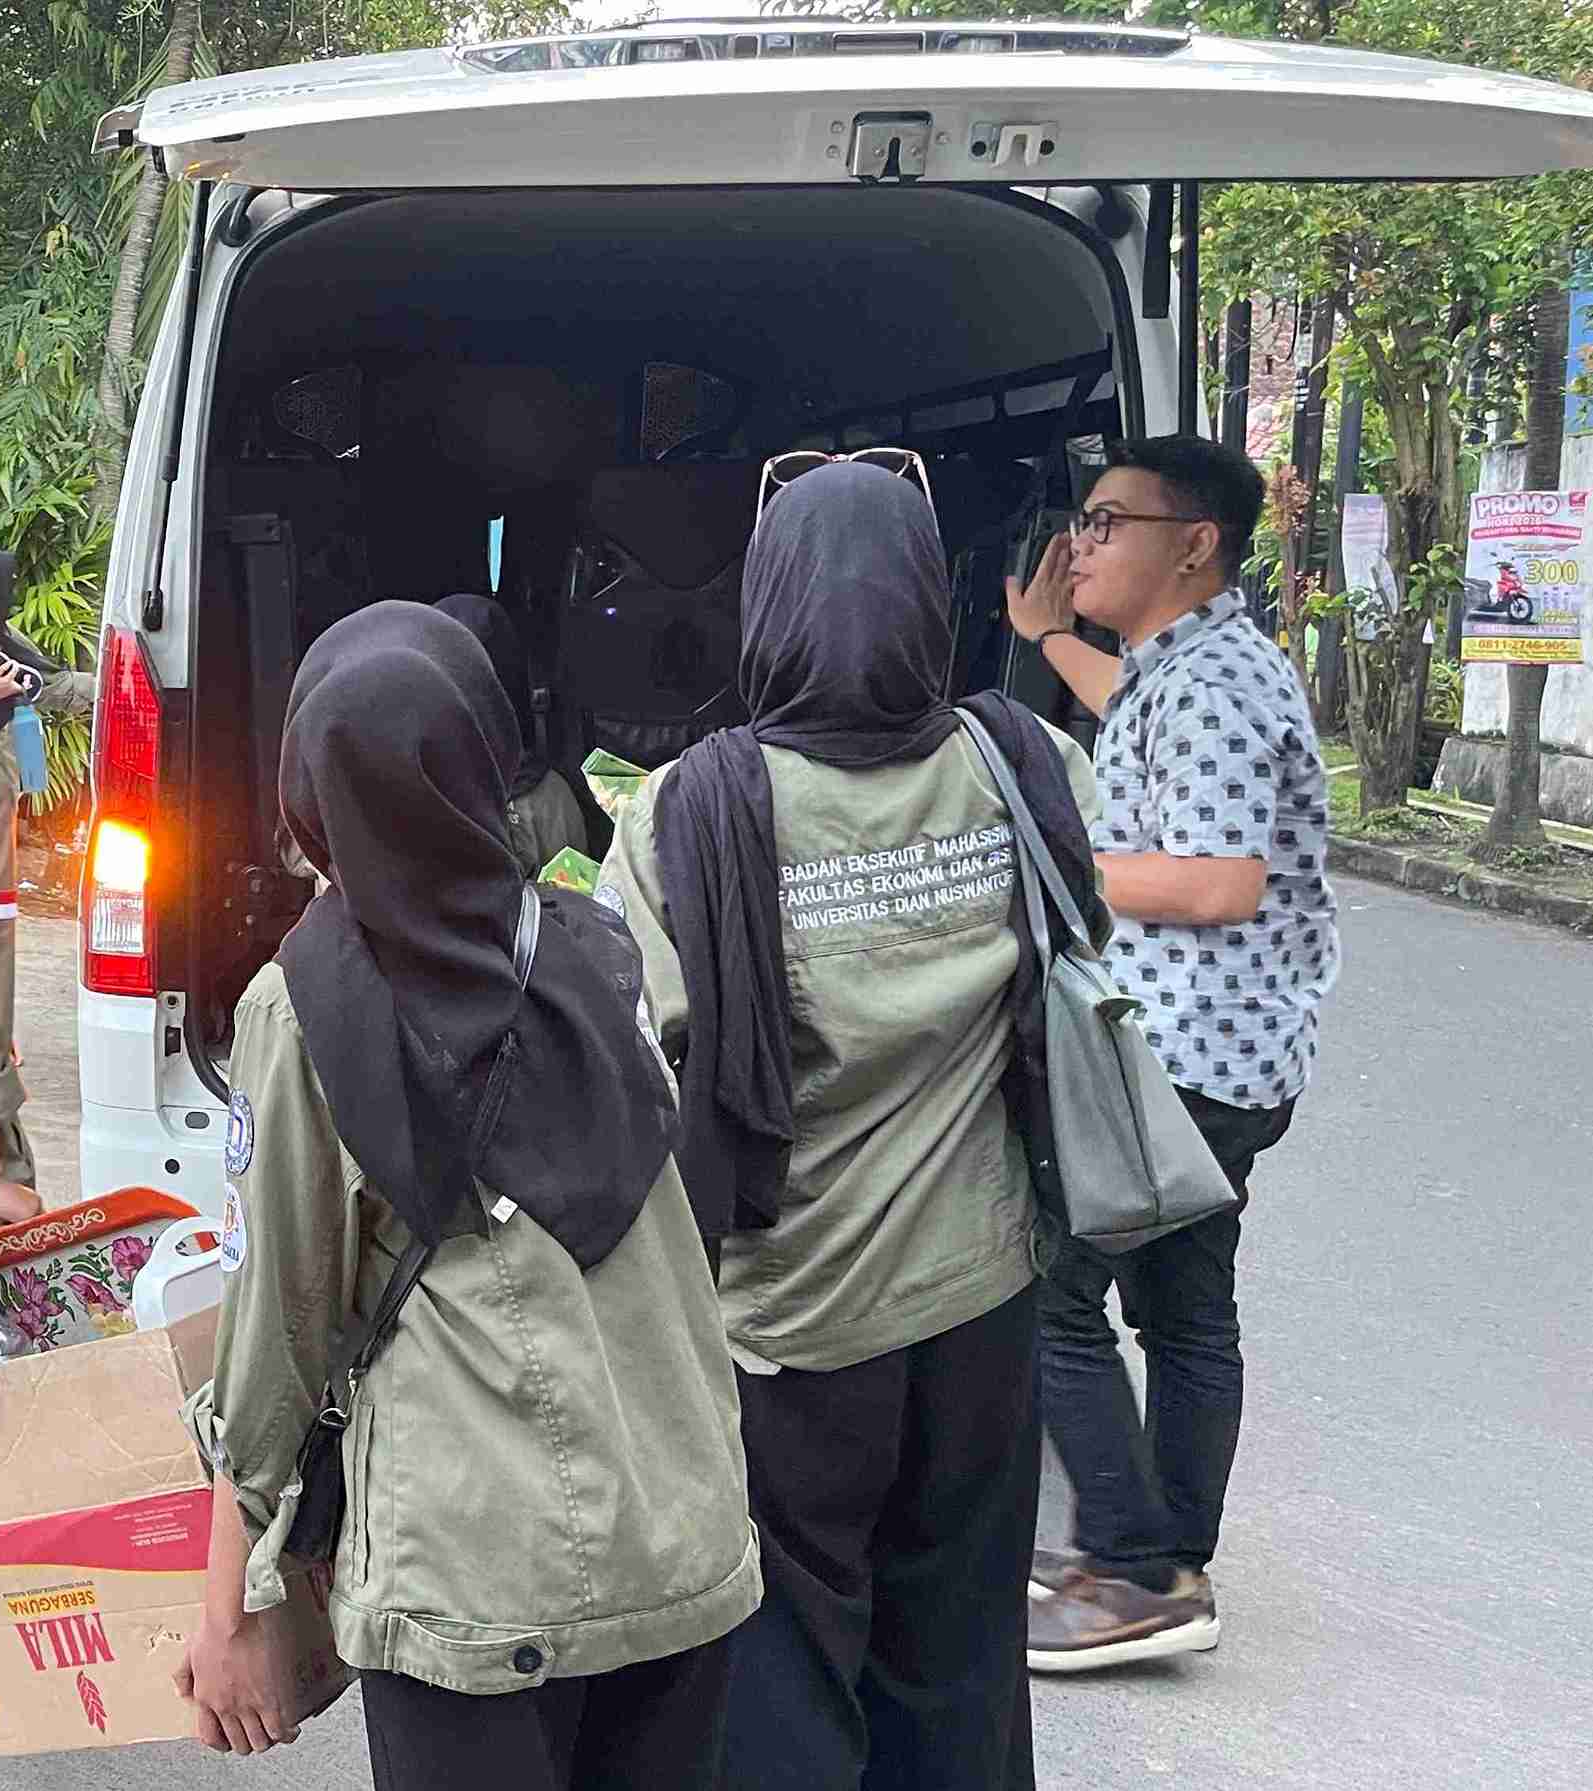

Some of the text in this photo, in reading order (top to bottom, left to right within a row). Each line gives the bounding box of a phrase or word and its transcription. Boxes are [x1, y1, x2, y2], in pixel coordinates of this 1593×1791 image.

[1475, 494, 1560, 520] PROMO
[1526, 559, 1578, 585] 300
[781, 857, 843, 883] BADAN
[846, 843, 927, 873] EKSEKUTIF
[871, 865, 945, 893] EKONOMI
[949, 855, 984, 878] DAN
[791, 900, 889, 930] UNIVERSITAS
[894, 892, 931, 914] DIAN
[8, 1590, 96, 1616] SERBAGUNA
[15, 1612, 115, 1671] MILA
